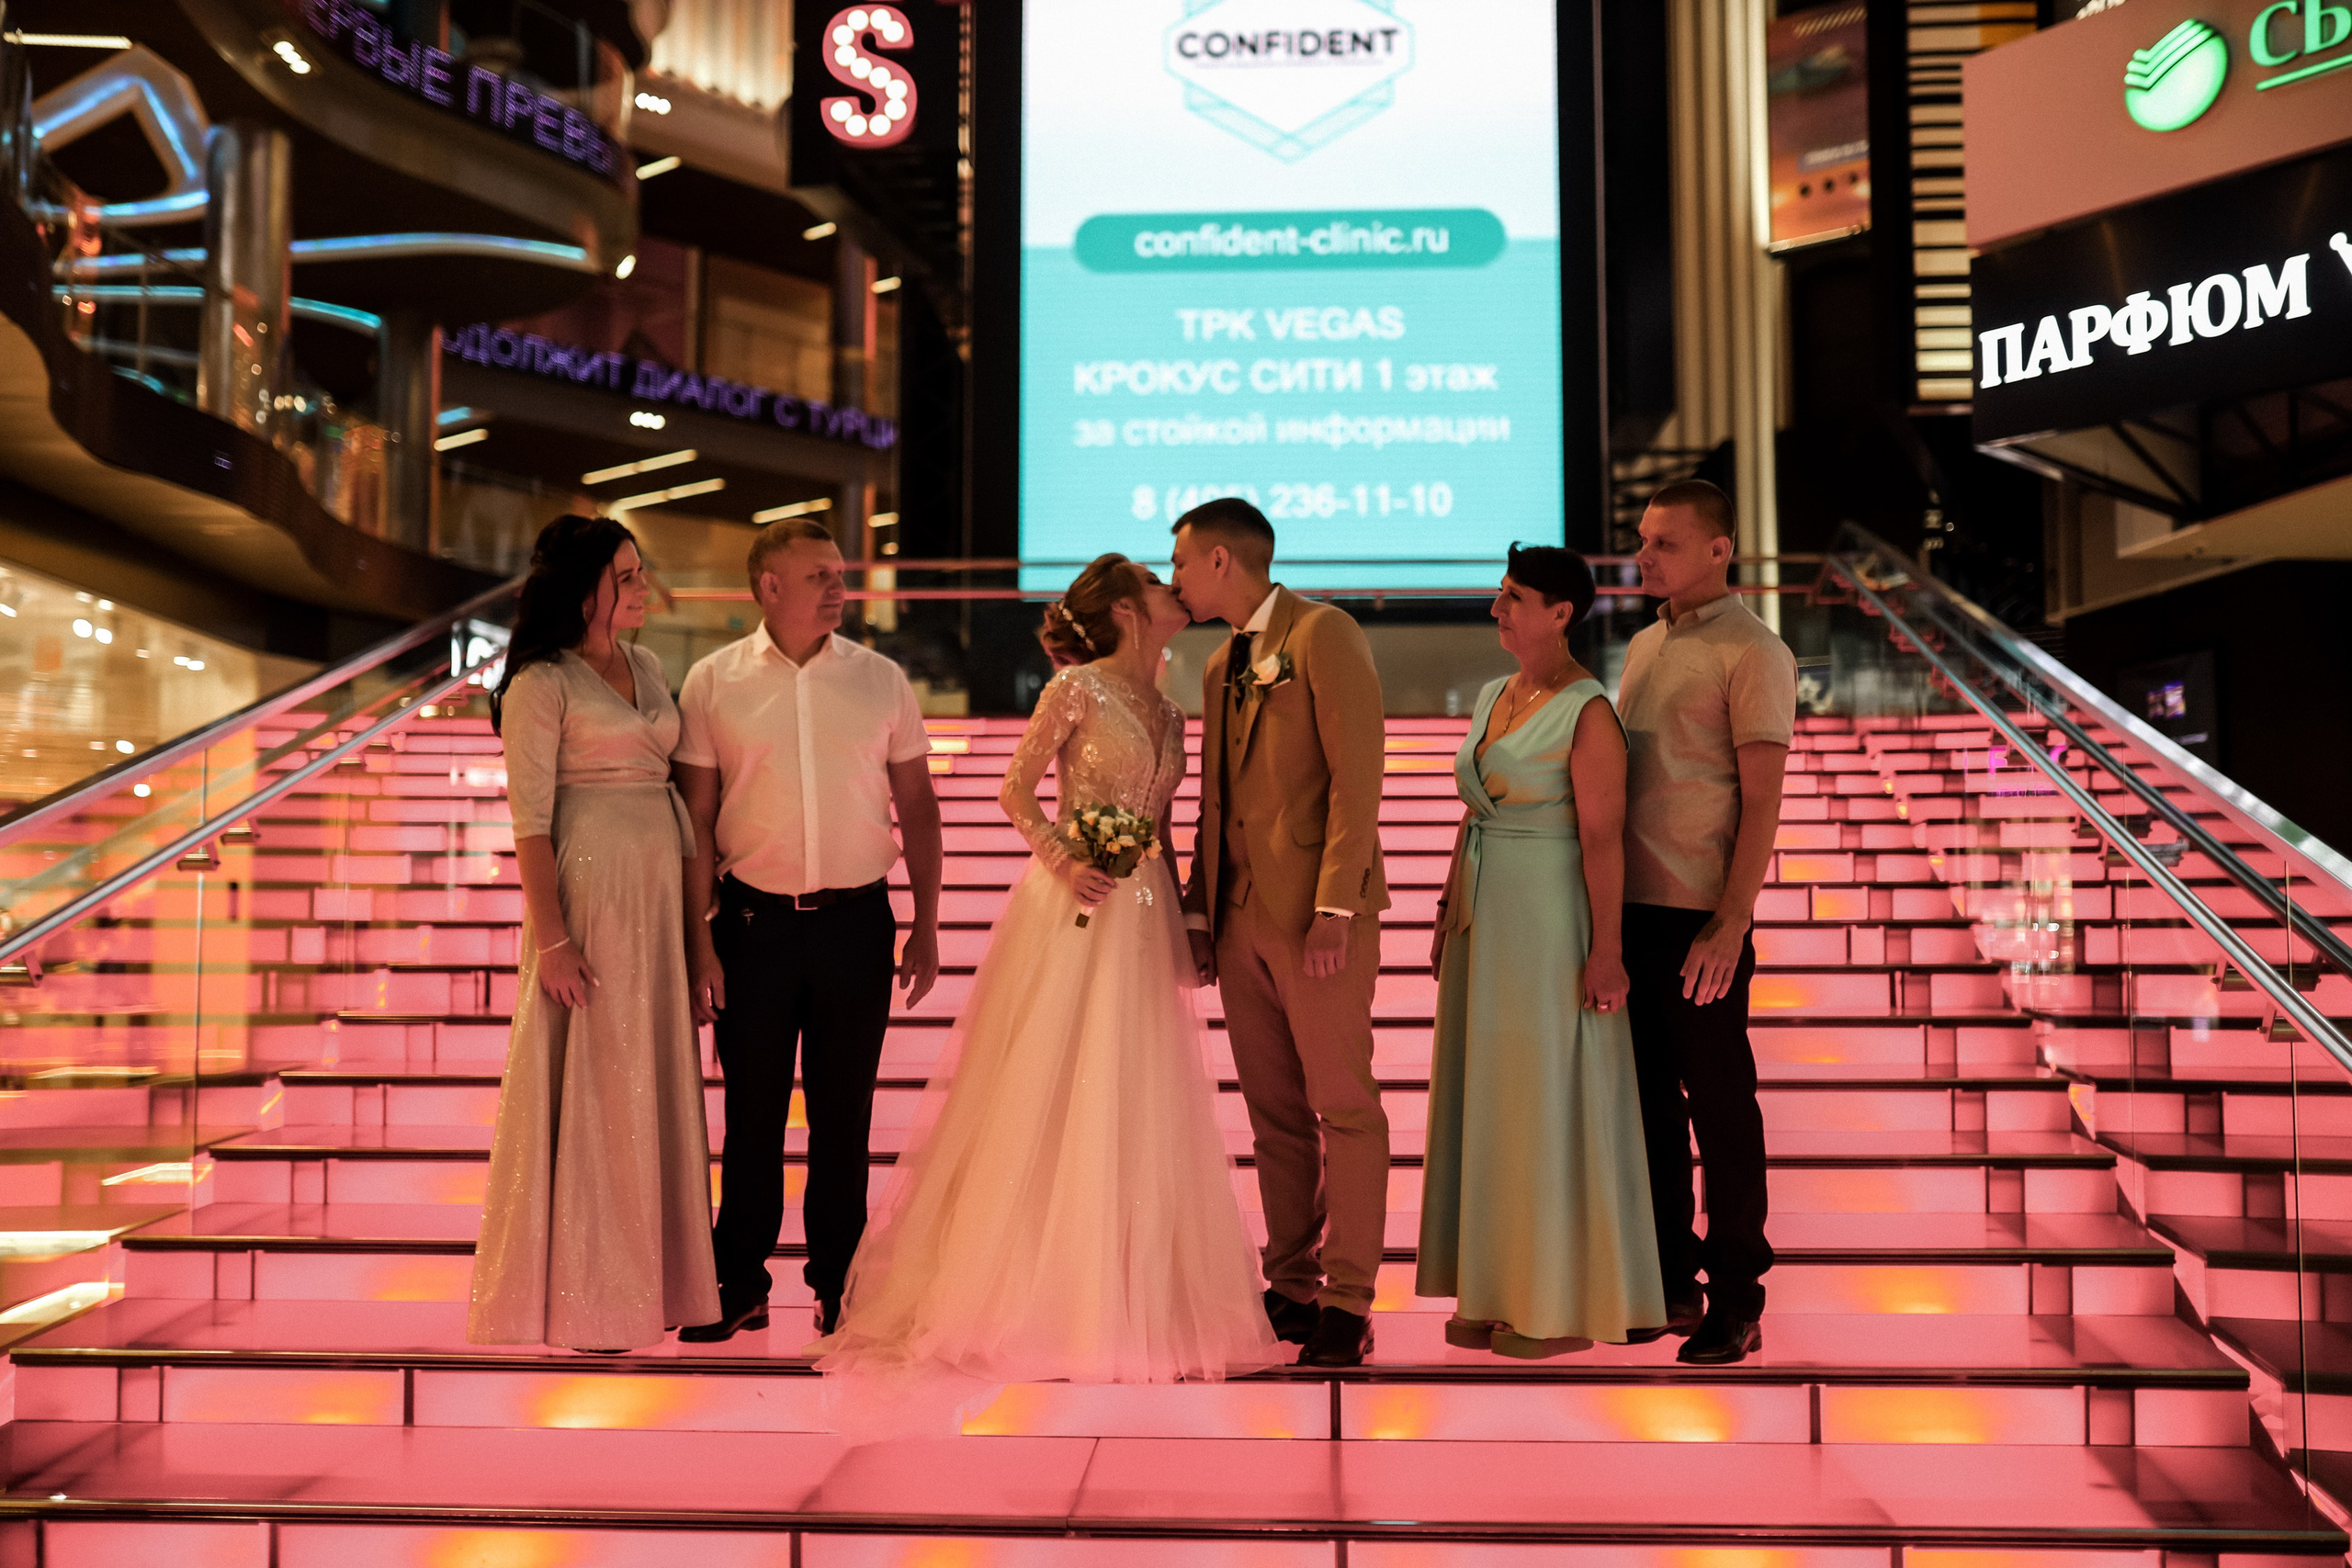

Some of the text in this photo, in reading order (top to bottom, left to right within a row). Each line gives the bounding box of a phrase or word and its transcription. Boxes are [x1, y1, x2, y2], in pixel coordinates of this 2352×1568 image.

[1177, 28, 1398, 60] CONFIDENT
[820, 4, 918, 149] S
[1134, 220, 1451, 257] confident-clinic.ru
[1176, 305, 1408, 342] ТРК VEGAS
[1979, 253, 2312, 389] ПАРФЮМ
[1073, 357, 1500, 396] КРОКУС СИТИ 1 этаж
[1073, 412, 1512, 451] за стойкой информации
[1132, 484, 1158, 521] 8
[1269, 481, 1454, 520] 236-11-10
